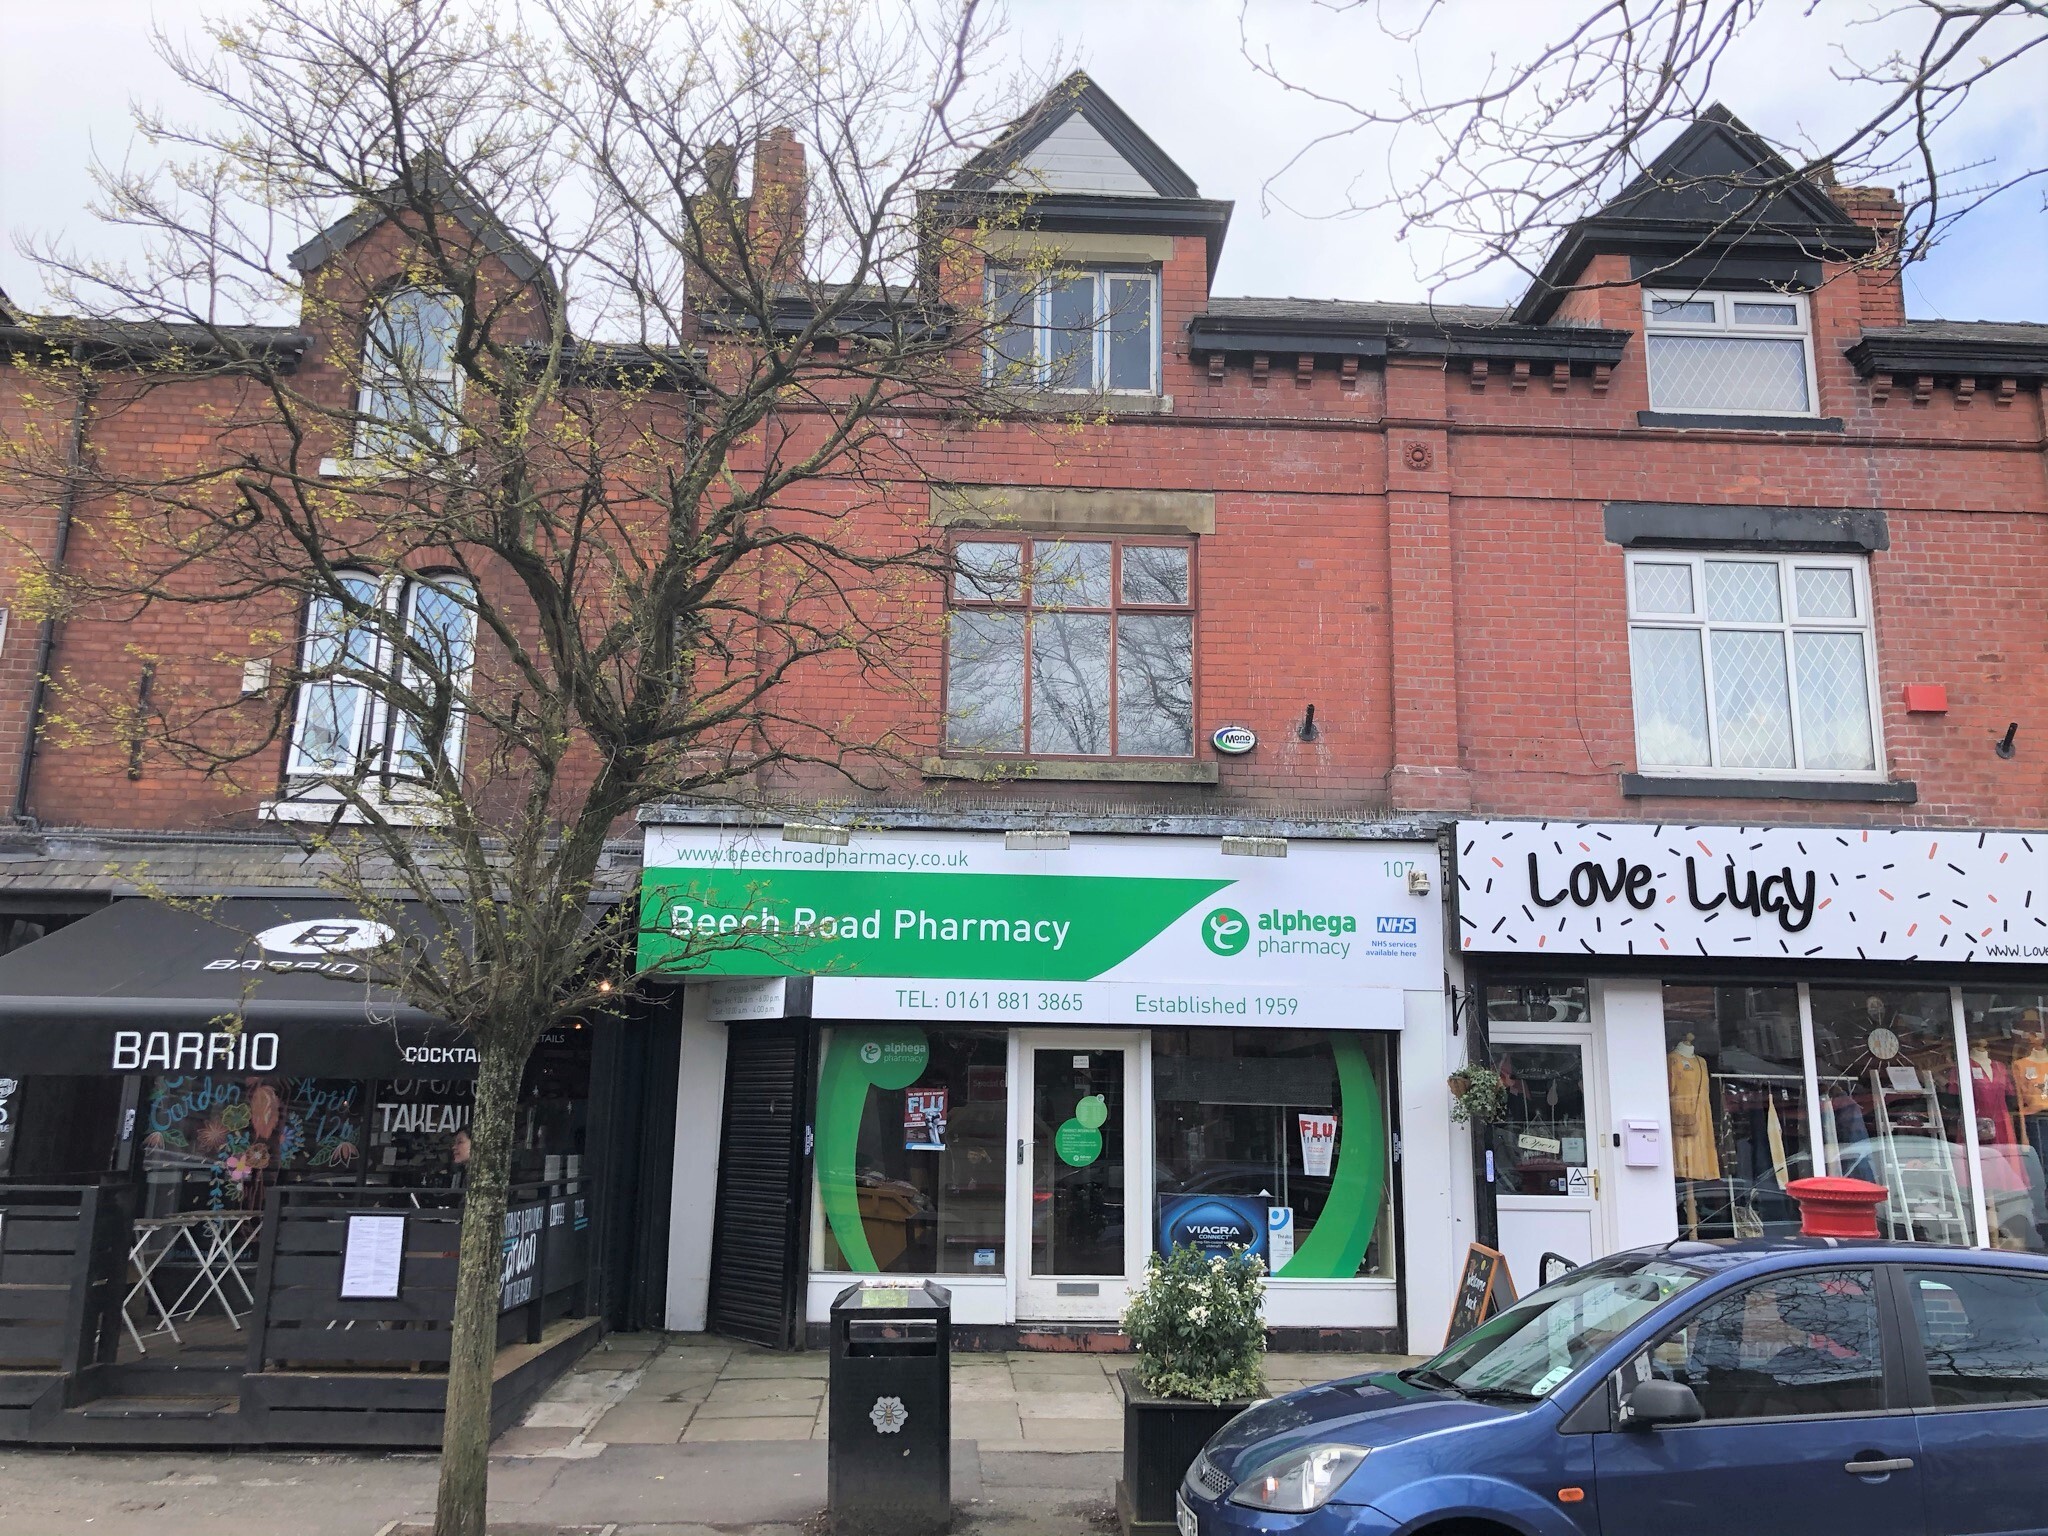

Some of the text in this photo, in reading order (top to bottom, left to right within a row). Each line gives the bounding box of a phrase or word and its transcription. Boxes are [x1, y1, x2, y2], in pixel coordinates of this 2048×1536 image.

[1225, 734, 1251, 744] Mono
[677, 845, 969, 868] www.beechroadpharmacy.co.uk
[1527, 852, 1816, 932] Love Lucy
[670, 904, 1071, 951] Beech Road Pharmacy
[1258, 909, 1357, 937] alphega
[1378, 917, 1415, 933] NHS
[1258, 936, 1351, 960] pharmacy
[1365, 949, 1417, 958] available here
[1371, 940, 1418, 949] NHS services
[895, 989, 1084, 1012] TEL: 0161 881 3865
[1135, 994, 1299, 1017] Established 1959
[112, 1029, 279, 1072] BARRIO
[883, 1042, 926, 1053] alphega
[883, 1054, 924, 1064] pharmacy
[150, 1075, 242, 1132] Garden
[907, 1096, 945, 1114] FLU
[1300, 1120, 1333, 1139] FLU
[1520, 1137, 1556, 1150] Open
[1186, 1225, 1241, 1236] VIAGRA
